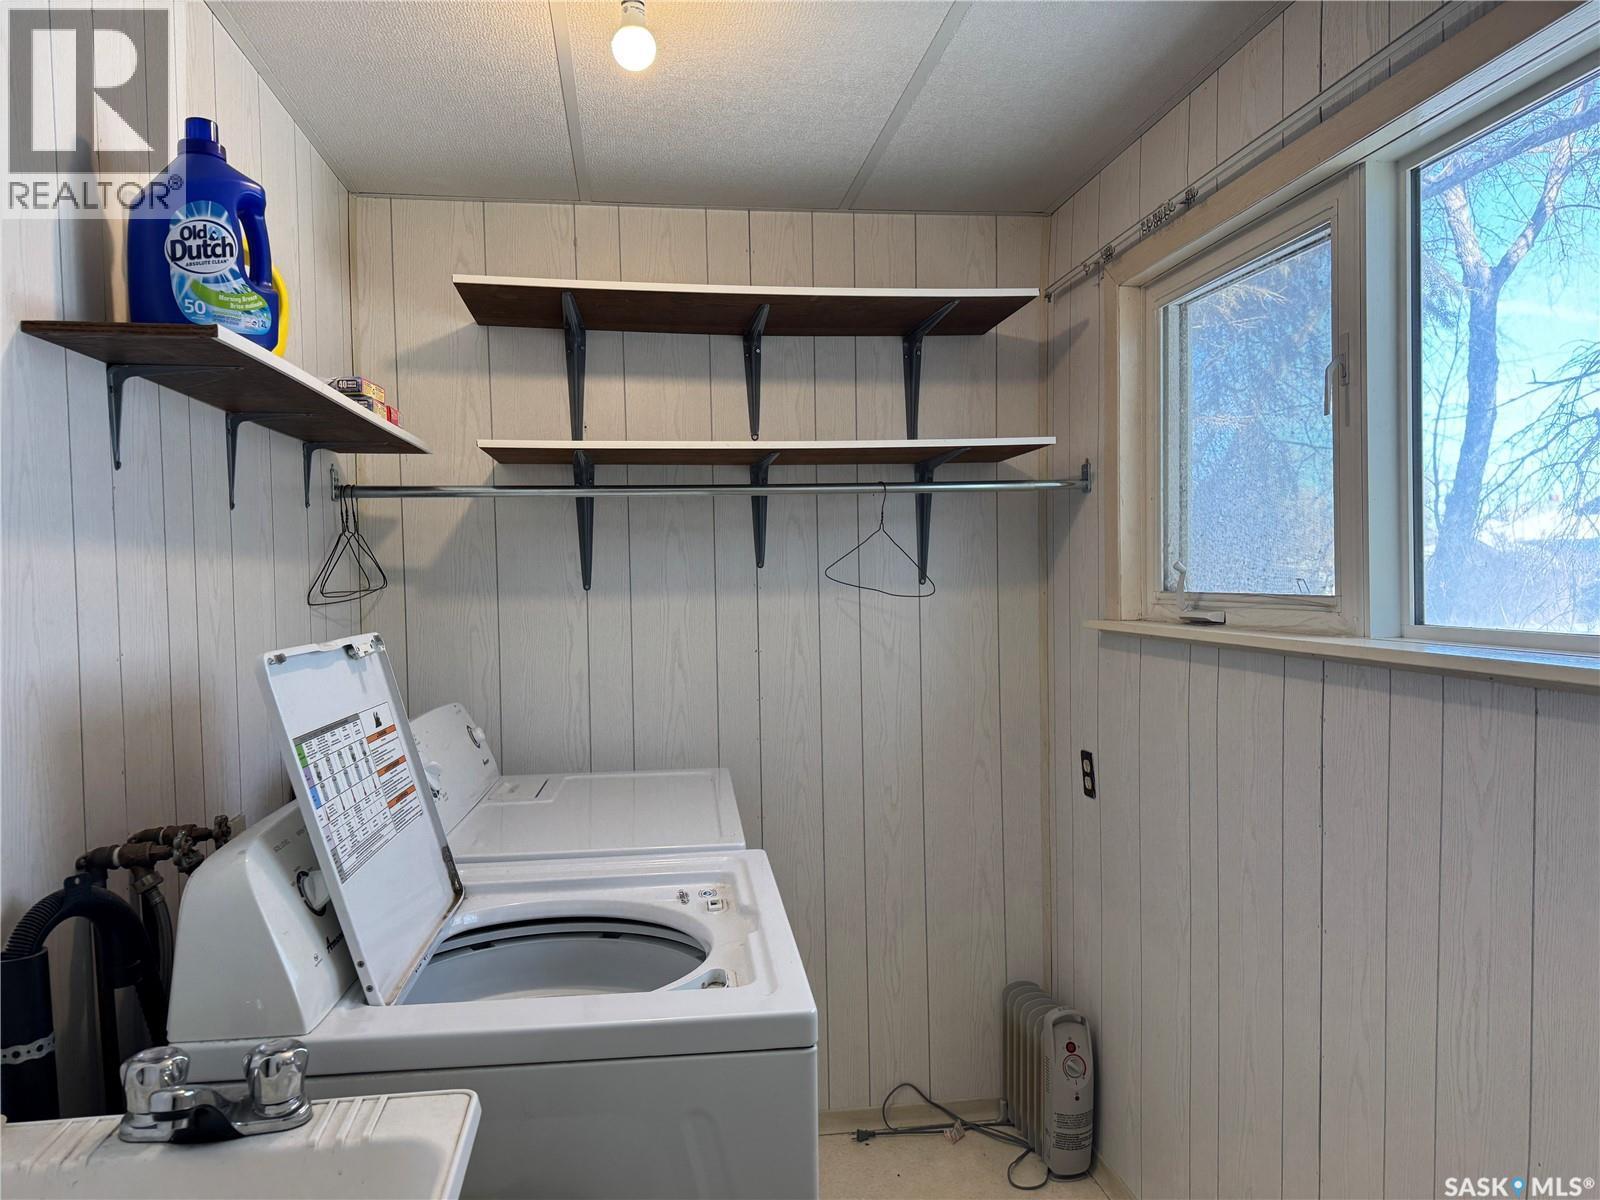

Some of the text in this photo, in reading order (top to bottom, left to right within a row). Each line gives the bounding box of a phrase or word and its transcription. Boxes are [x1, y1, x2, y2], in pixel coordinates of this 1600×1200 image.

[179, 224, 207, 241] Old
[170, 236, 234, 262] Dutch
[184, 299, 206, 314] 50
[338, 380, 347, 388] 40
